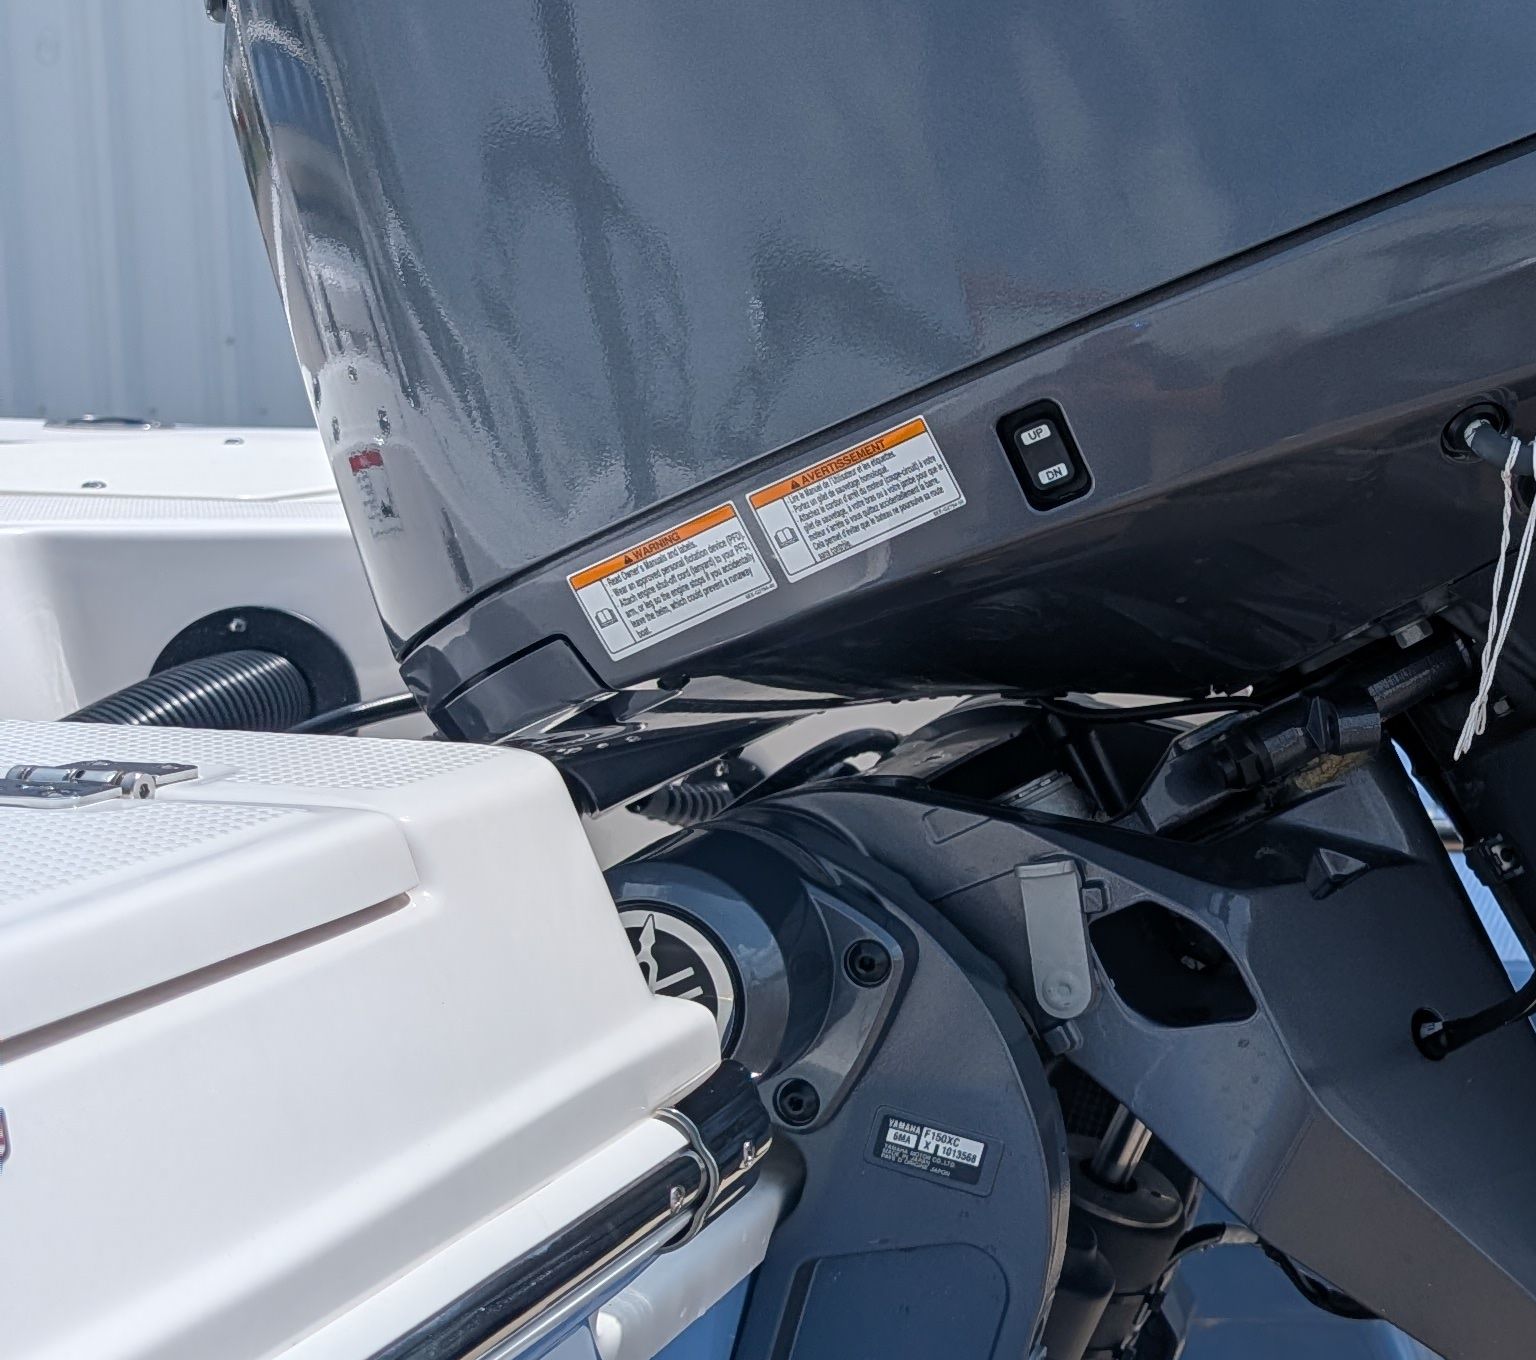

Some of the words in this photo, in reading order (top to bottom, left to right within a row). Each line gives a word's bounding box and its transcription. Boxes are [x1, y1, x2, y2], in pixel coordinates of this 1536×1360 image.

[1028, 428, 1043, 441] UP
[800, 439, 888, 485] AVERTISSEMENT
[1045, 467, 1063, 481] DN
[632, 532, 681, 560] WARNING
[889, 1118, 921, 1135] YAMAHA
[893, 1132, 911, 1145] 6MA
[924, 1129, 961, 1148] F150XC
[924, 1141, 931, 1151] X
[942, 1146, 977, 1164] 1013568
